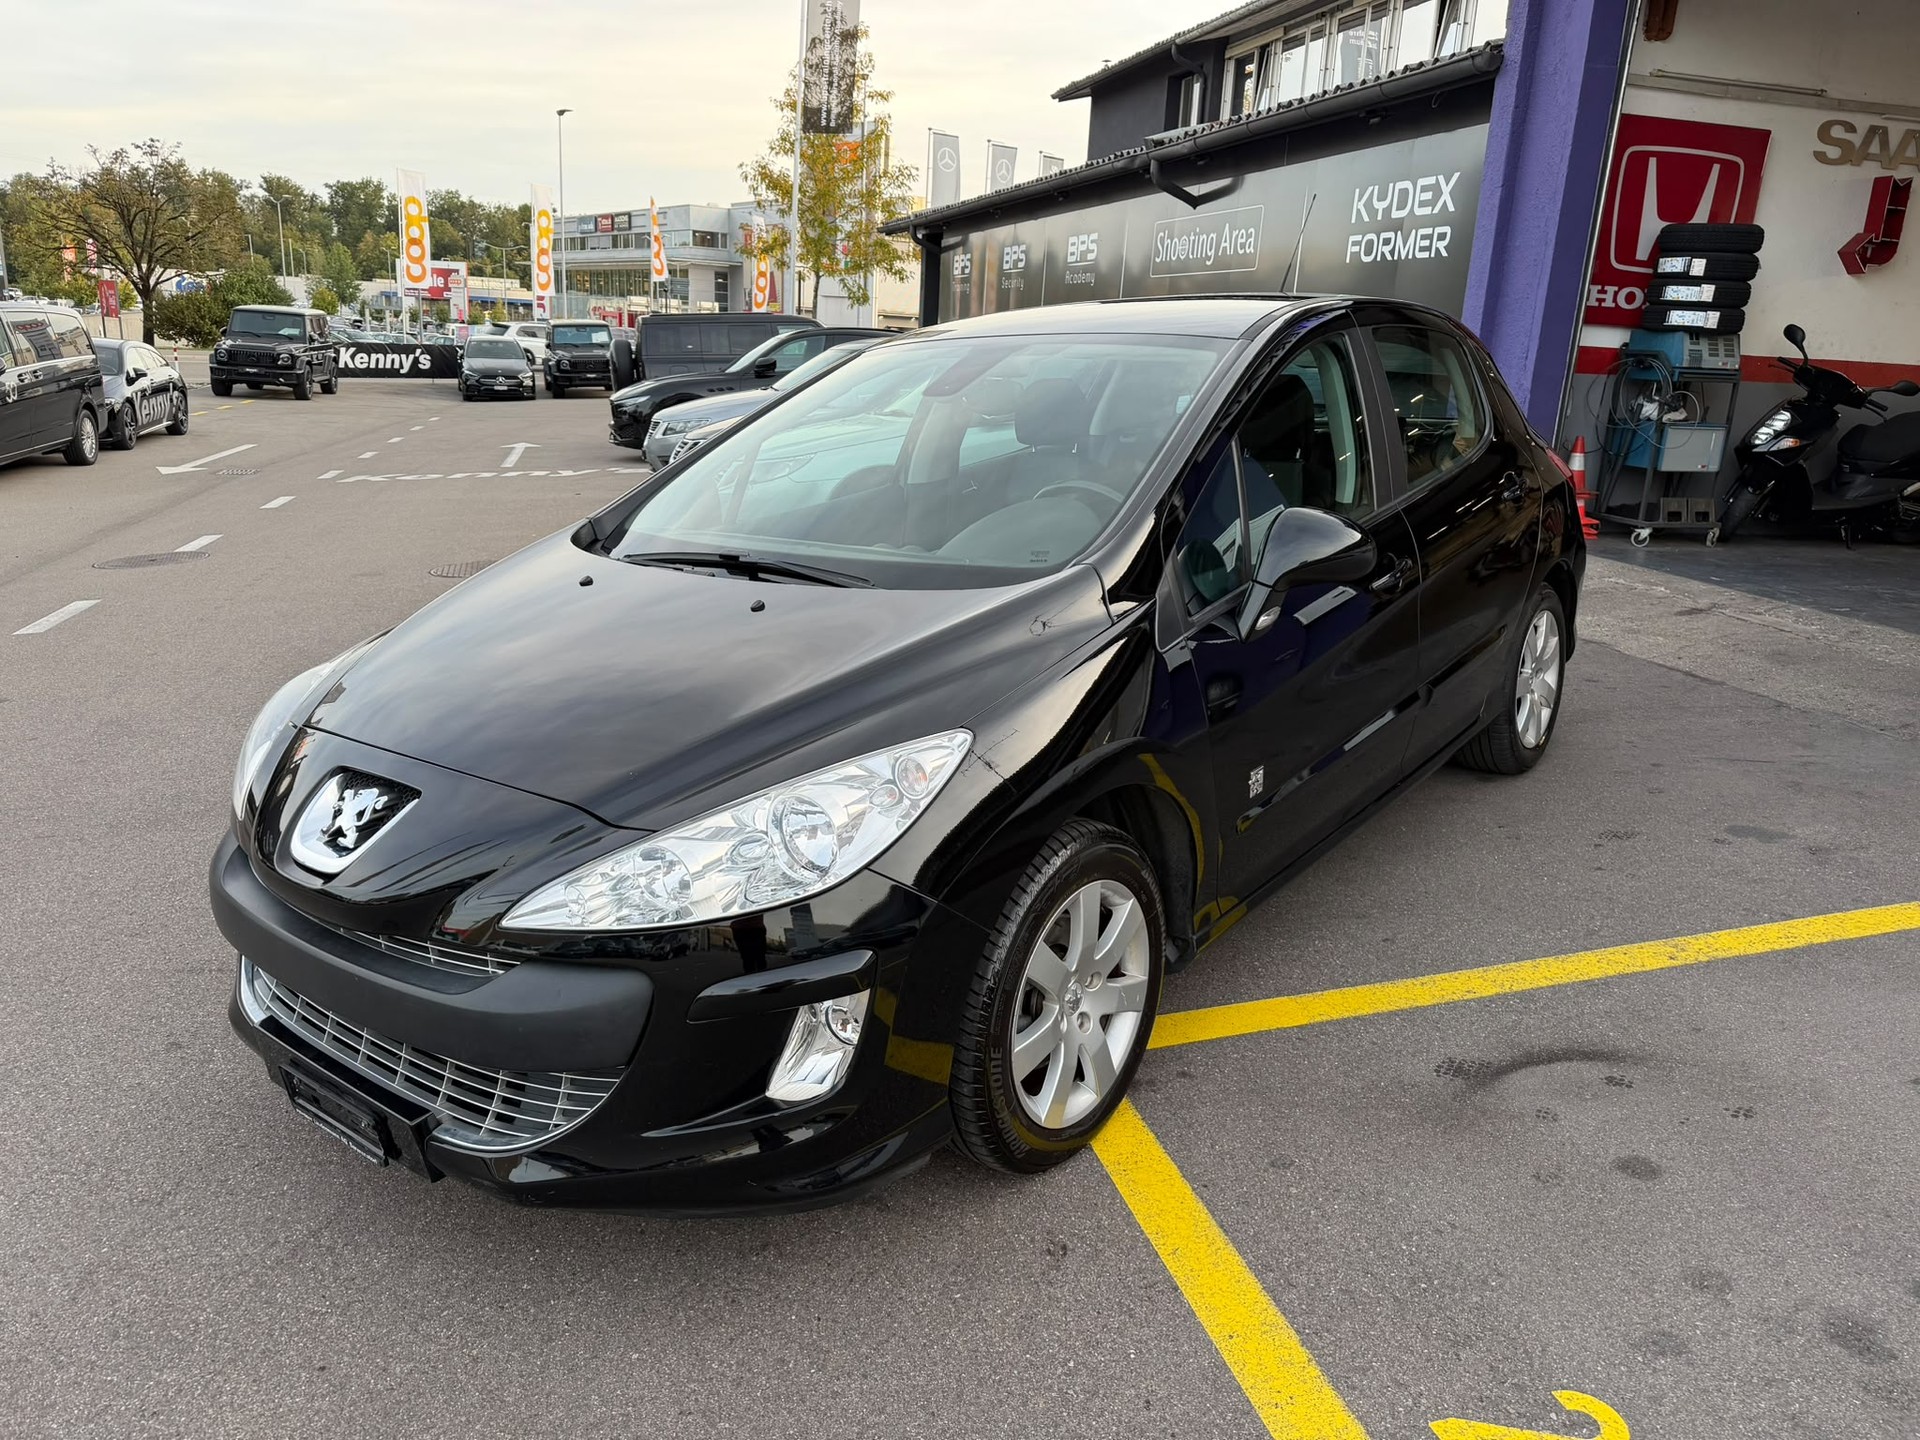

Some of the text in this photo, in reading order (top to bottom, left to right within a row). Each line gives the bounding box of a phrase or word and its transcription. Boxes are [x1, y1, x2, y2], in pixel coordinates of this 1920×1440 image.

[1350, 171, 1461, 224] KYDEX
[404, 196, 429, 284] coop
[536, 209, 554, 291] coop
[1067, 233, 1099, 263] BPS
[1155, 222, 1255, 265] Shooting Area
[1346, 225, 1452, 263] FORMER
[953, 253, 971, 275] BPS
[1003, 244, 1027, 271] BPS
[1001, 277, 1024, 291] Security
[1065, 271, 1096, 286] Academy
[338, 346, 432, 374] Kenny's
